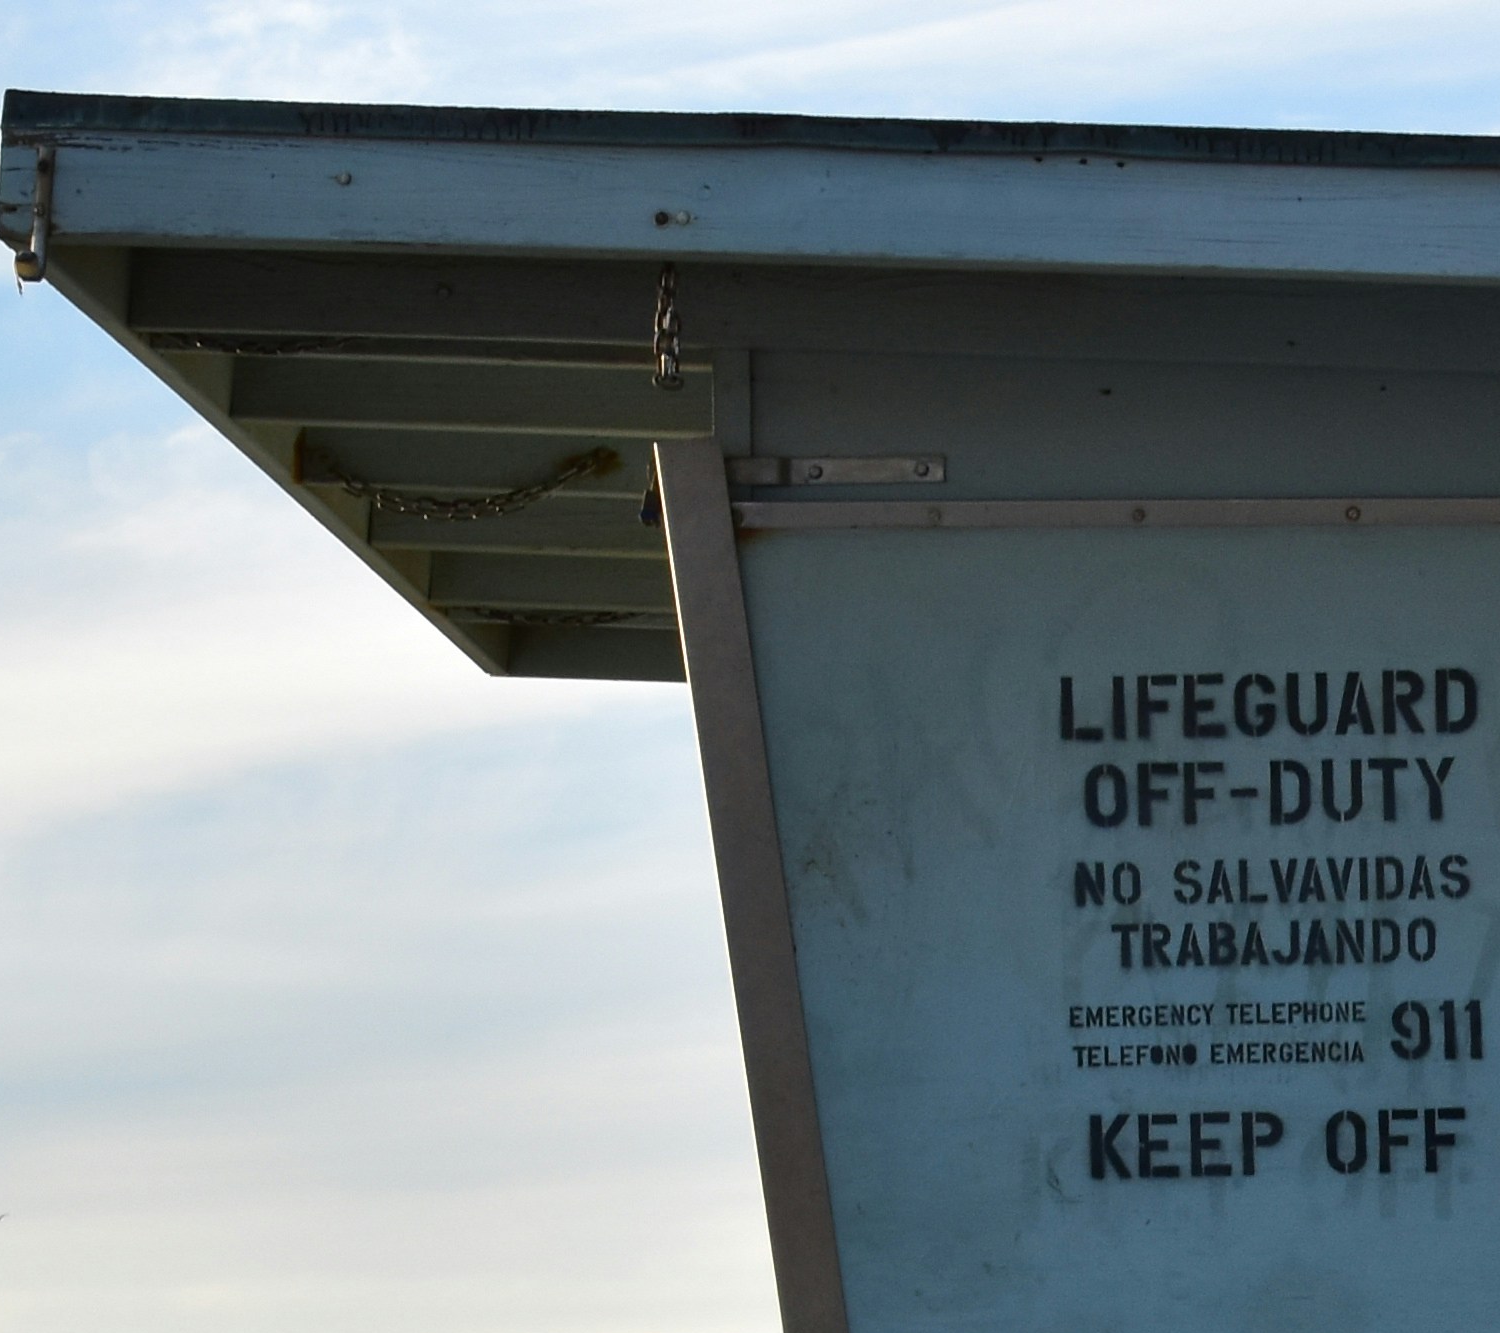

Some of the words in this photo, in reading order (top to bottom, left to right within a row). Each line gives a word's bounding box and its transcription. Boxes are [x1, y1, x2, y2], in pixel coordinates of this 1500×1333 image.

[1059, 667, 1479, 744] LIFEGUARD
[1083, 756, 1455, 829] OFF-DUTY
[1073, 861, 1142, 910] NO
[1173, 854, 1472, 906] SALVAVIDAS
[1110, 916, 1437, 972] TRABAJANDO
[1068, 1003, 1215, 1029] EMERGENCY
[1224, 1000, 1367, 1026] TELEPHONE
[1390, 999, 1484, 1062] 911
[1072, 1042, 1198, 1069] TELEFONO
[1210, 1040, 1365, 1065] EMERGENCIA
[1088, 1111, 1285, 1182] KEEP
[1324, 1106, 1467, 1175] OFF
